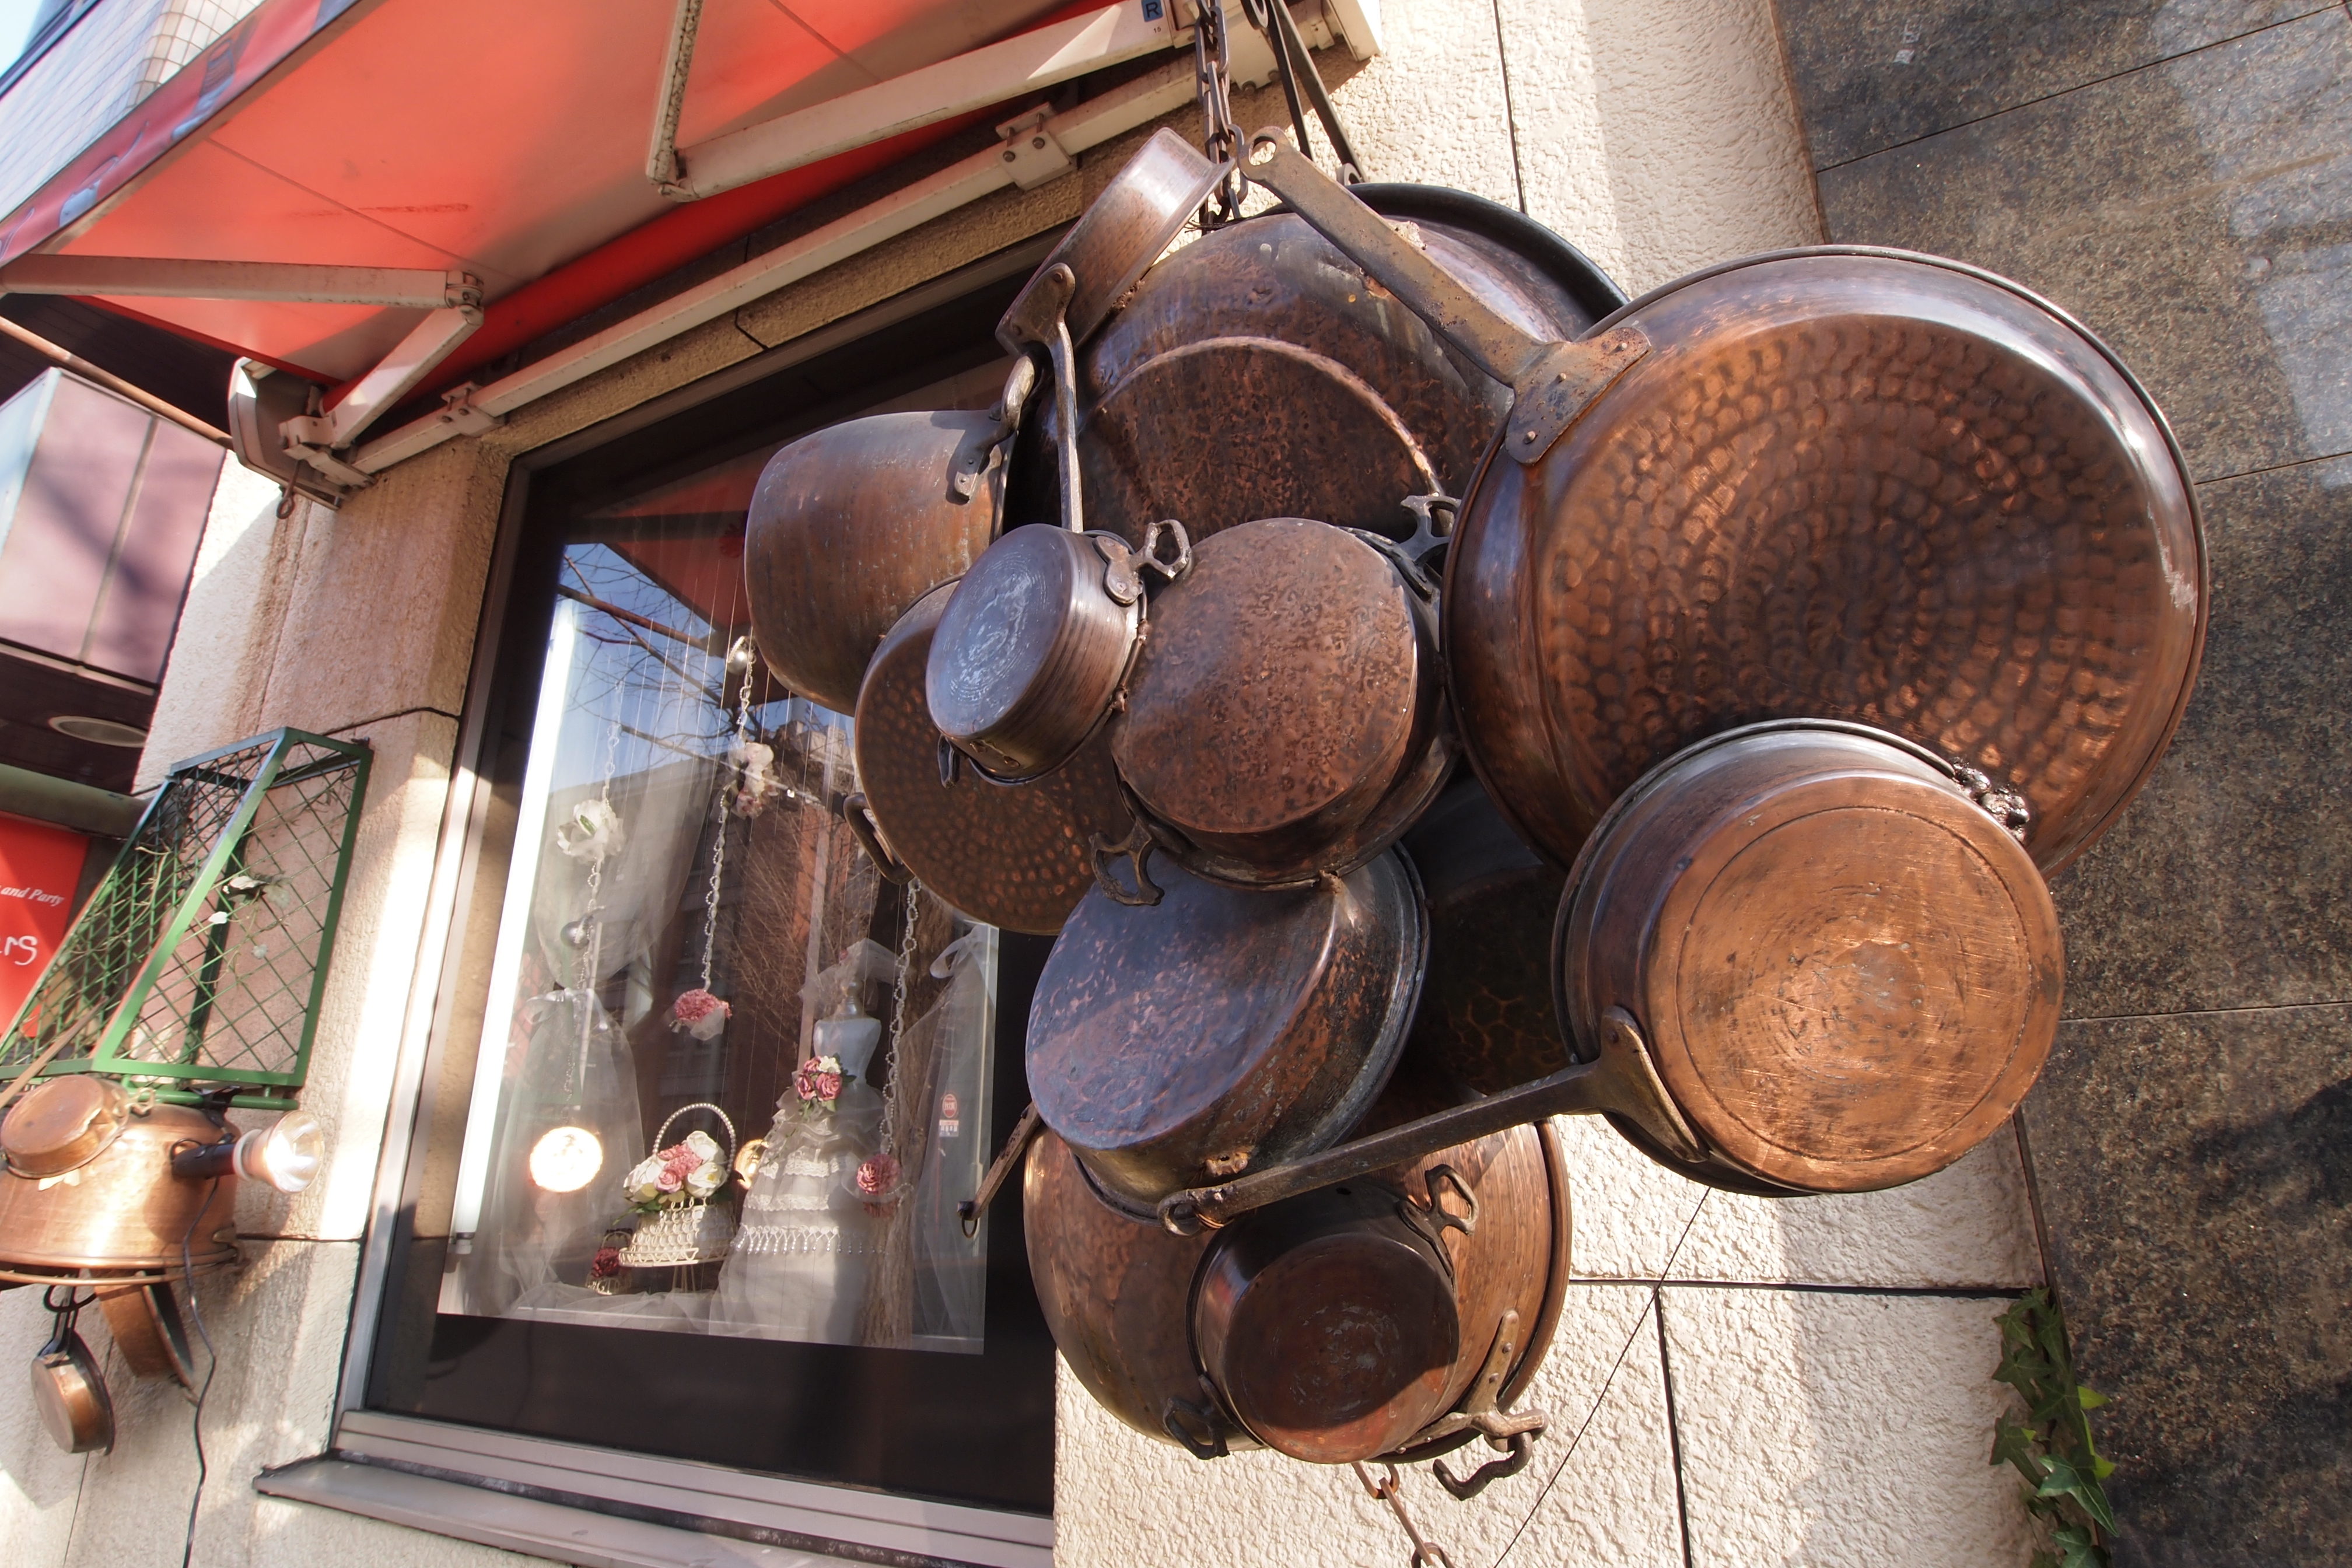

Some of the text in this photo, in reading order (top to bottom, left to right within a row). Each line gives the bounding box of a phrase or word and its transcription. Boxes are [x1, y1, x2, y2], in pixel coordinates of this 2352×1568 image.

[1145, 1, 1159, 18] R
[1, 887, 65, 907] and Party
